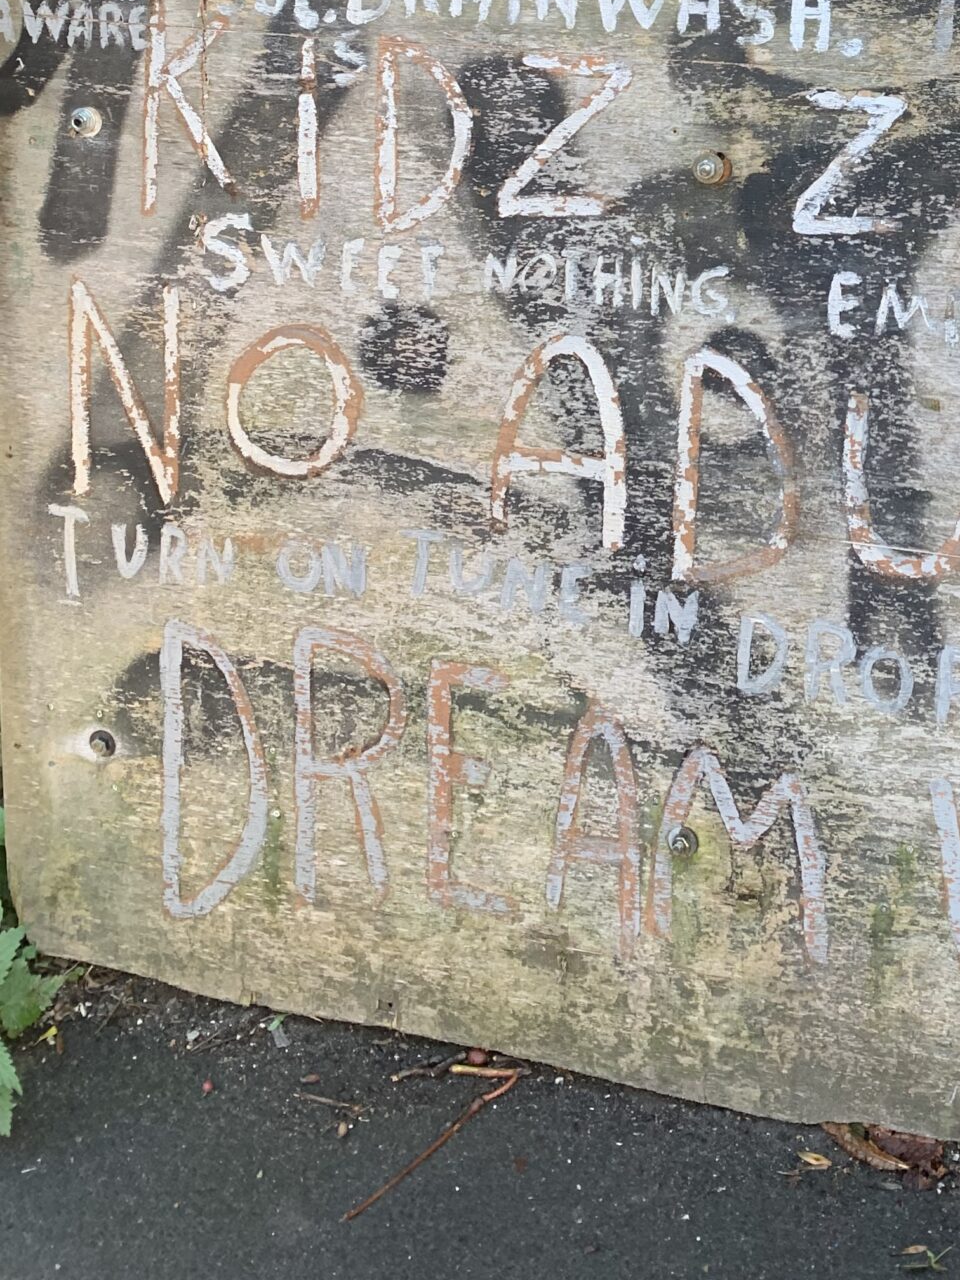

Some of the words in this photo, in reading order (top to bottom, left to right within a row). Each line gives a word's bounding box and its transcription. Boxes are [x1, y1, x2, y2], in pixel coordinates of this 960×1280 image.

[202, 212, 445, 300] SWEET
[68, 275, 364, 508] NO
[48, 503, 236, 599] TURN
[276, 536, 368, 597] ON
[400, 528, 593, 624] TUNE
[159, 618, 830, 965] DREAM
